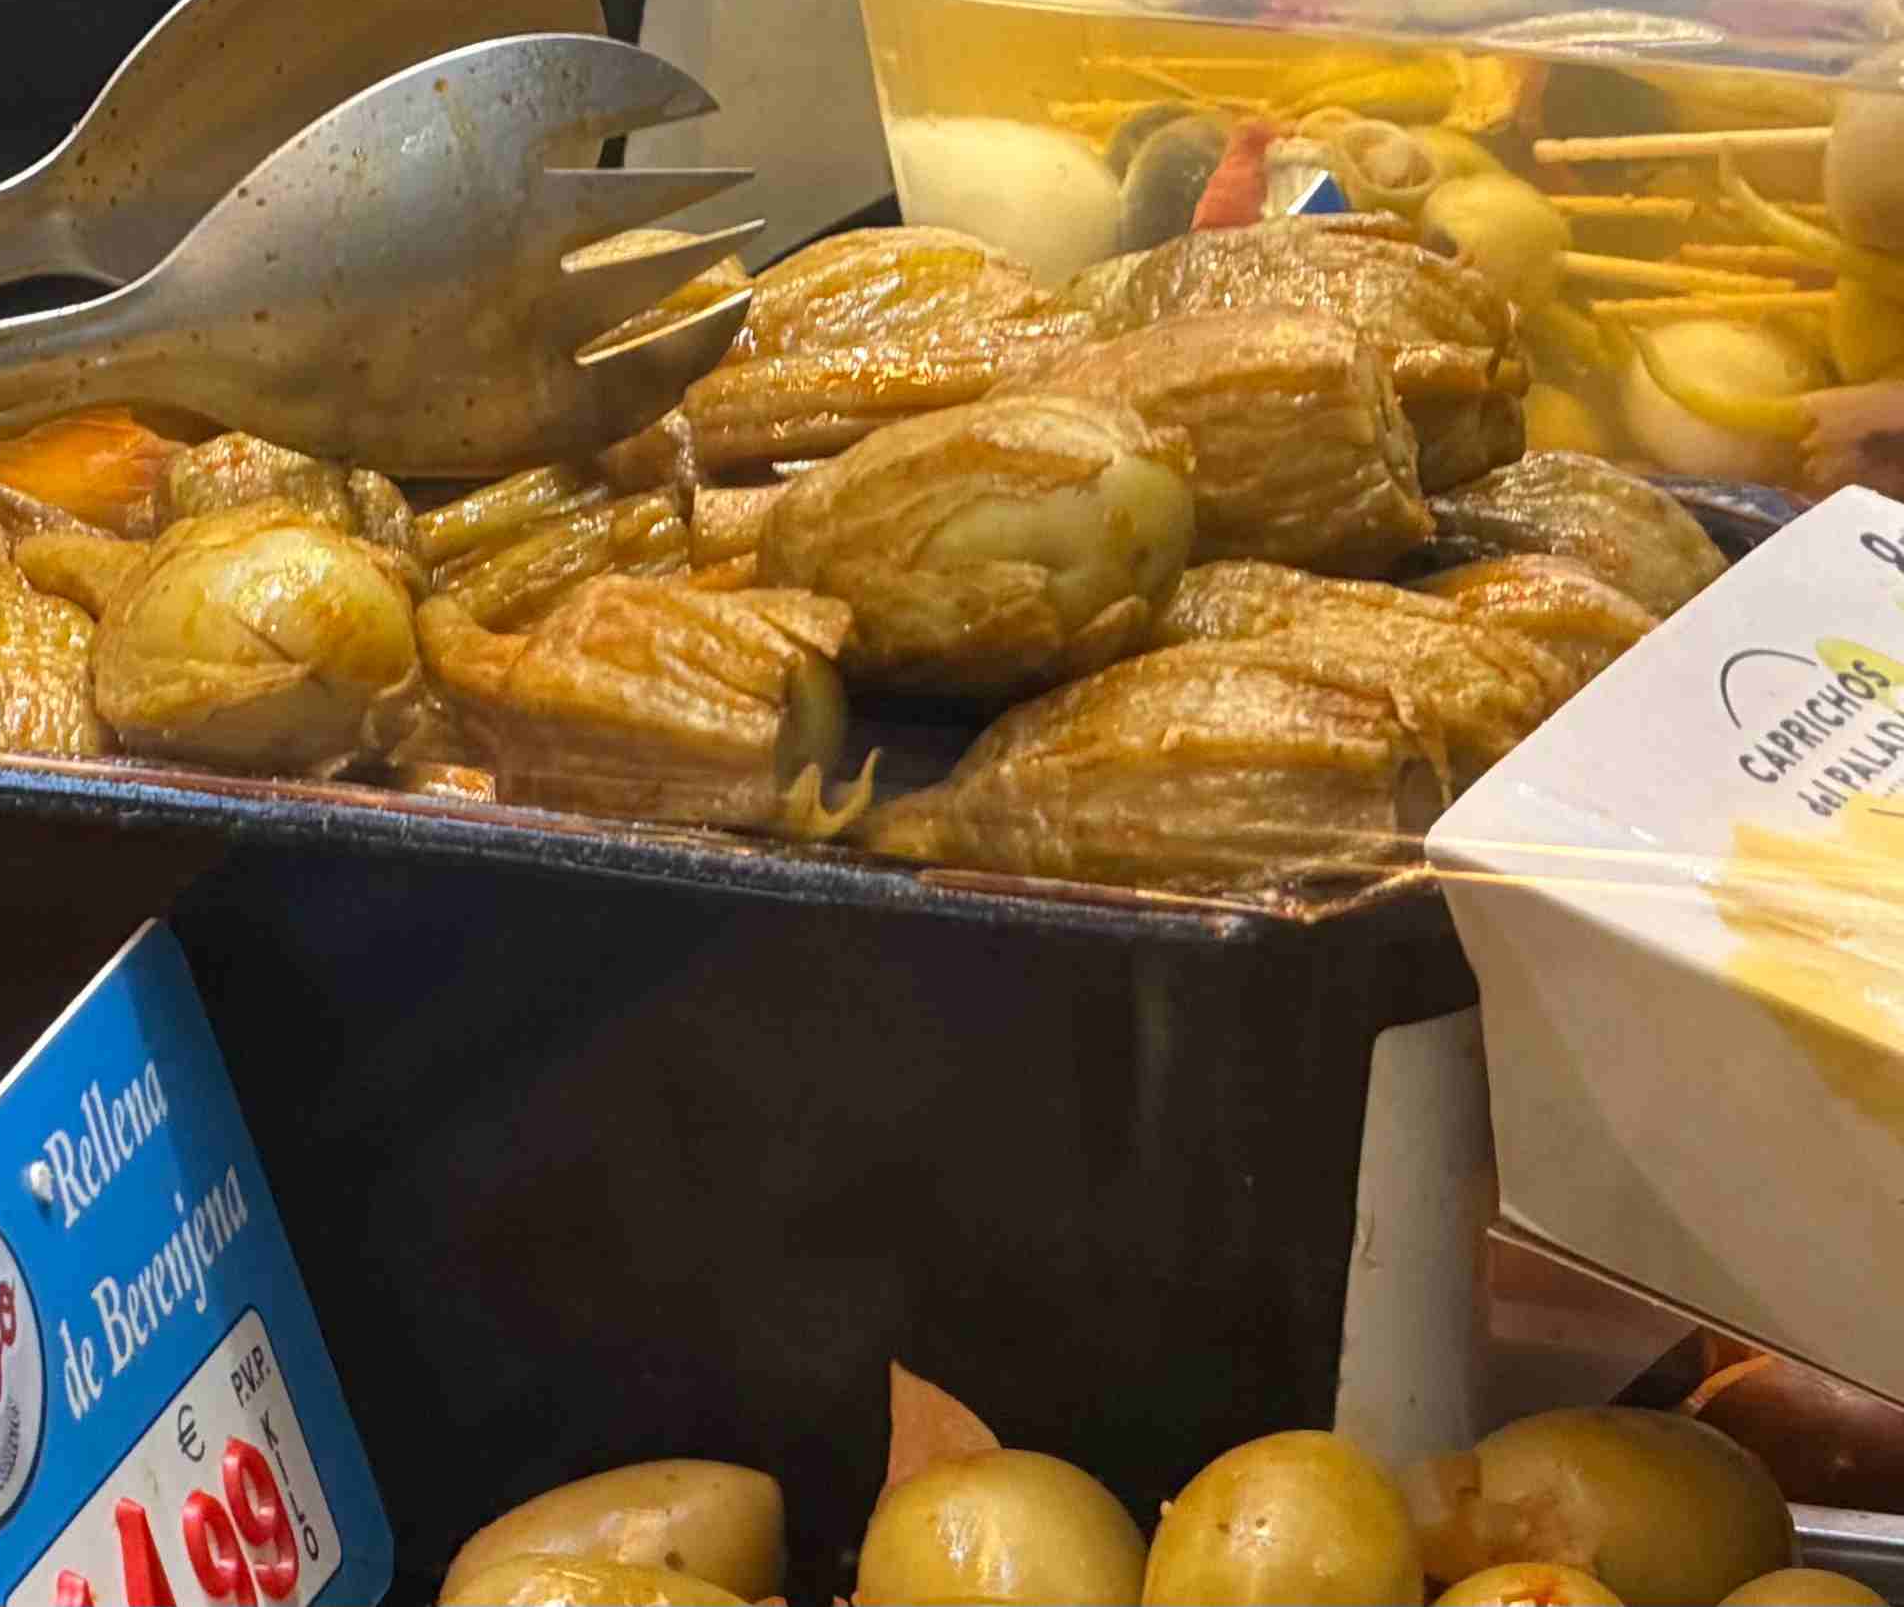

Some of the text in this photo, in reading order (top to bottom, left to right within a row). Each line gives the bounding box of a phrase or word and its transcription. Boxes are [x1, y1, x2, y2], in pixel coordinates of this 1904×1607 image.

[1738, 659, 1891, 783] CAPRICHOS
[1797, 778, 1849, 818] del
[43, 1058, 169, 1229] Rellena
[59, 1163, 250, 1421] de Berenjena
